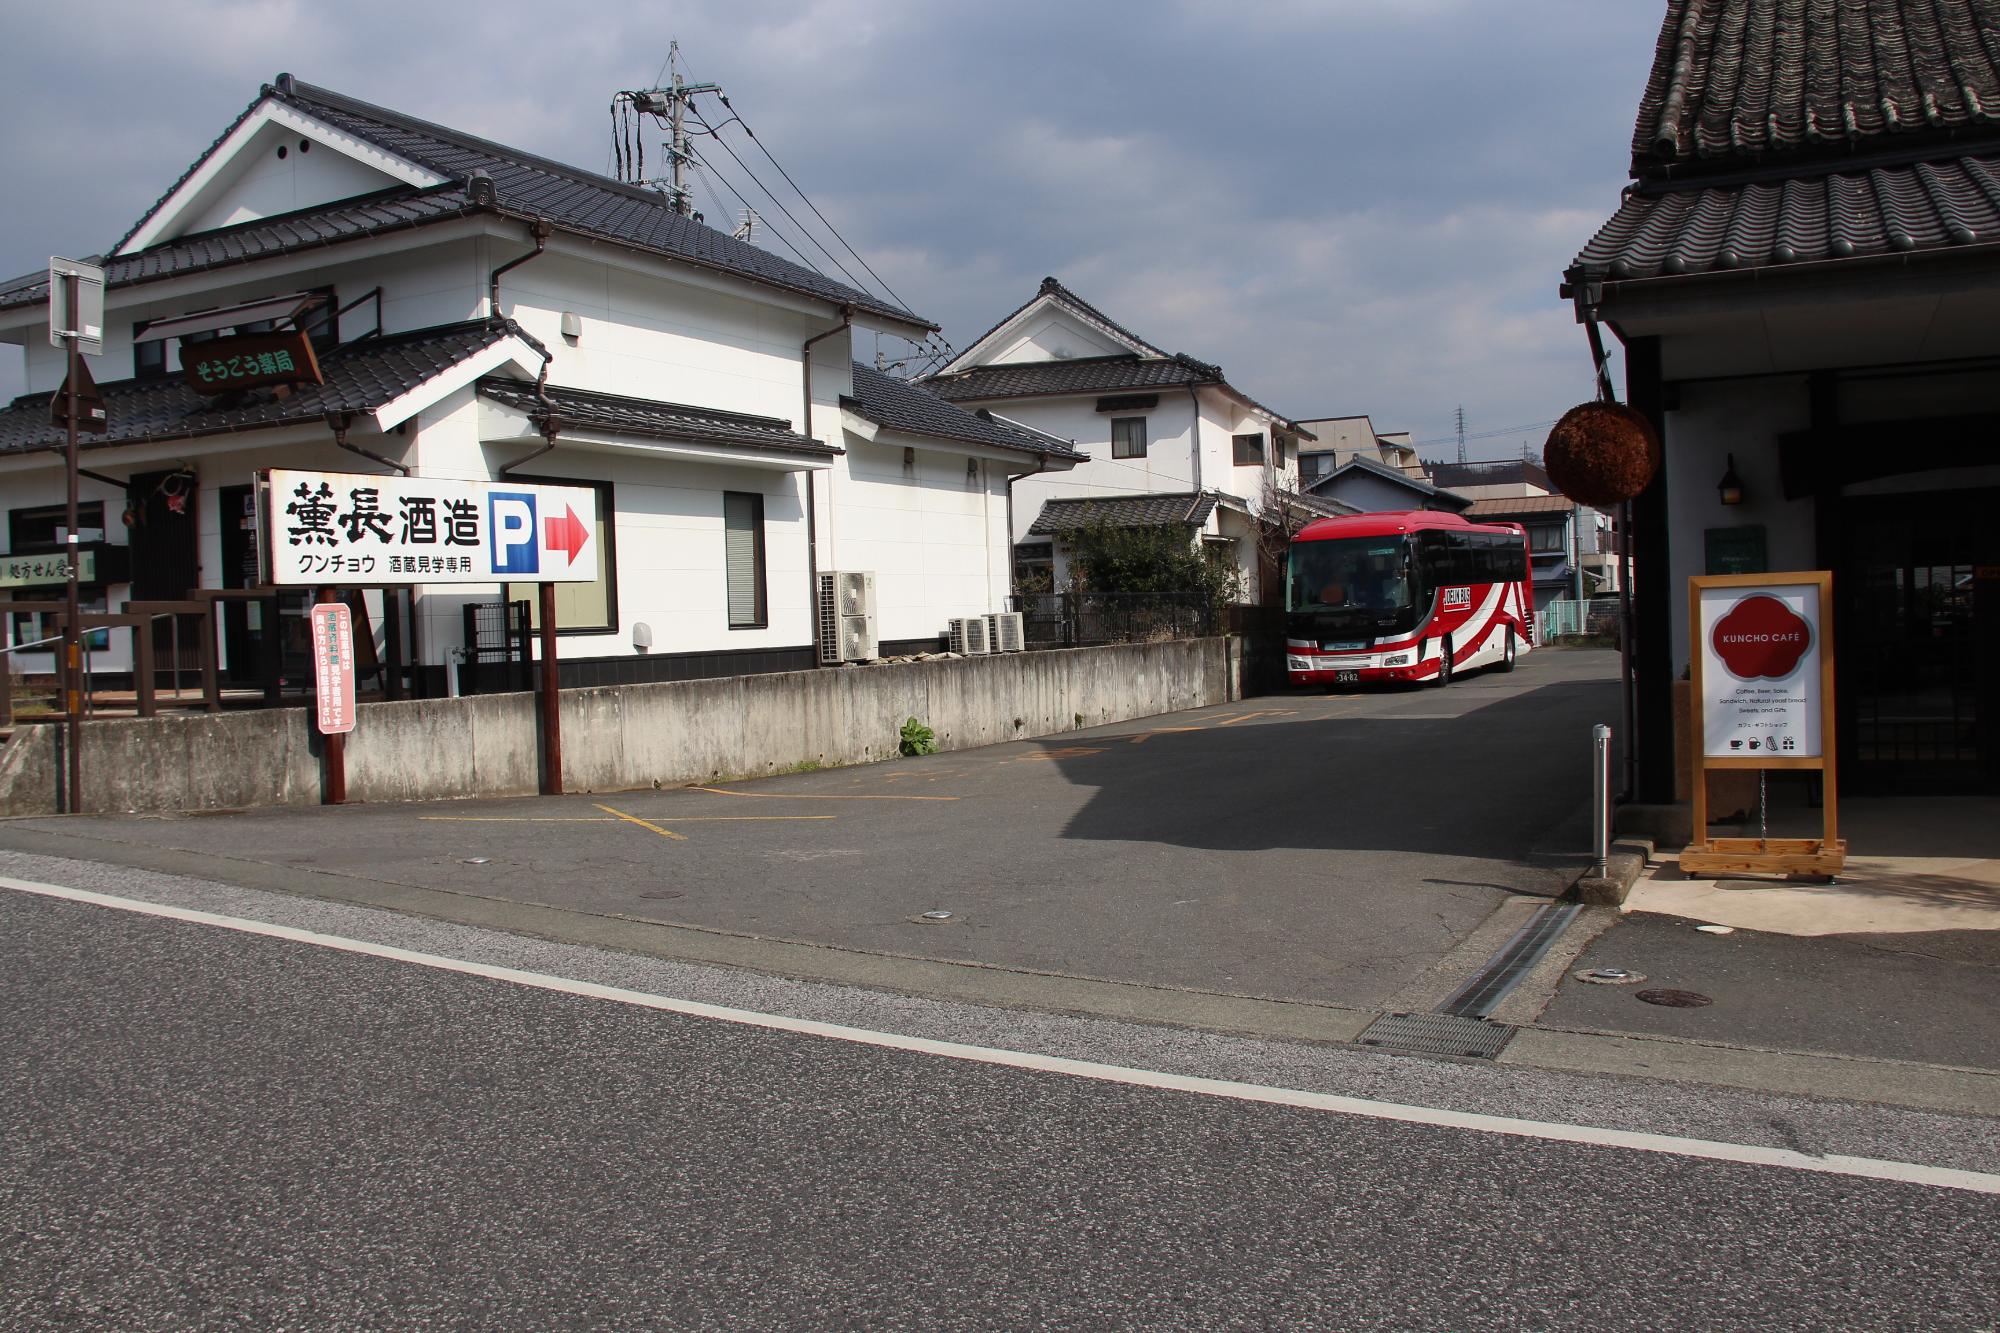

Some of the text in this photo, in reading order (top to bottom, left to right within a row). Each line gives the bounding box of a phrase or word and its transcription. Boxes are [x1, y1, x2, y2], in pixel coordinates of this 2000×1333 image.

[197, 350, 295, 382] そうごう薬局
[493, 499, 533, 567] P
[298, 554, 472, 574] クンチョウ 酒蔵見学専用
[1460, 588, 1470, 602] BUS
[1723, 634, 1769, 643] KUNCHO
